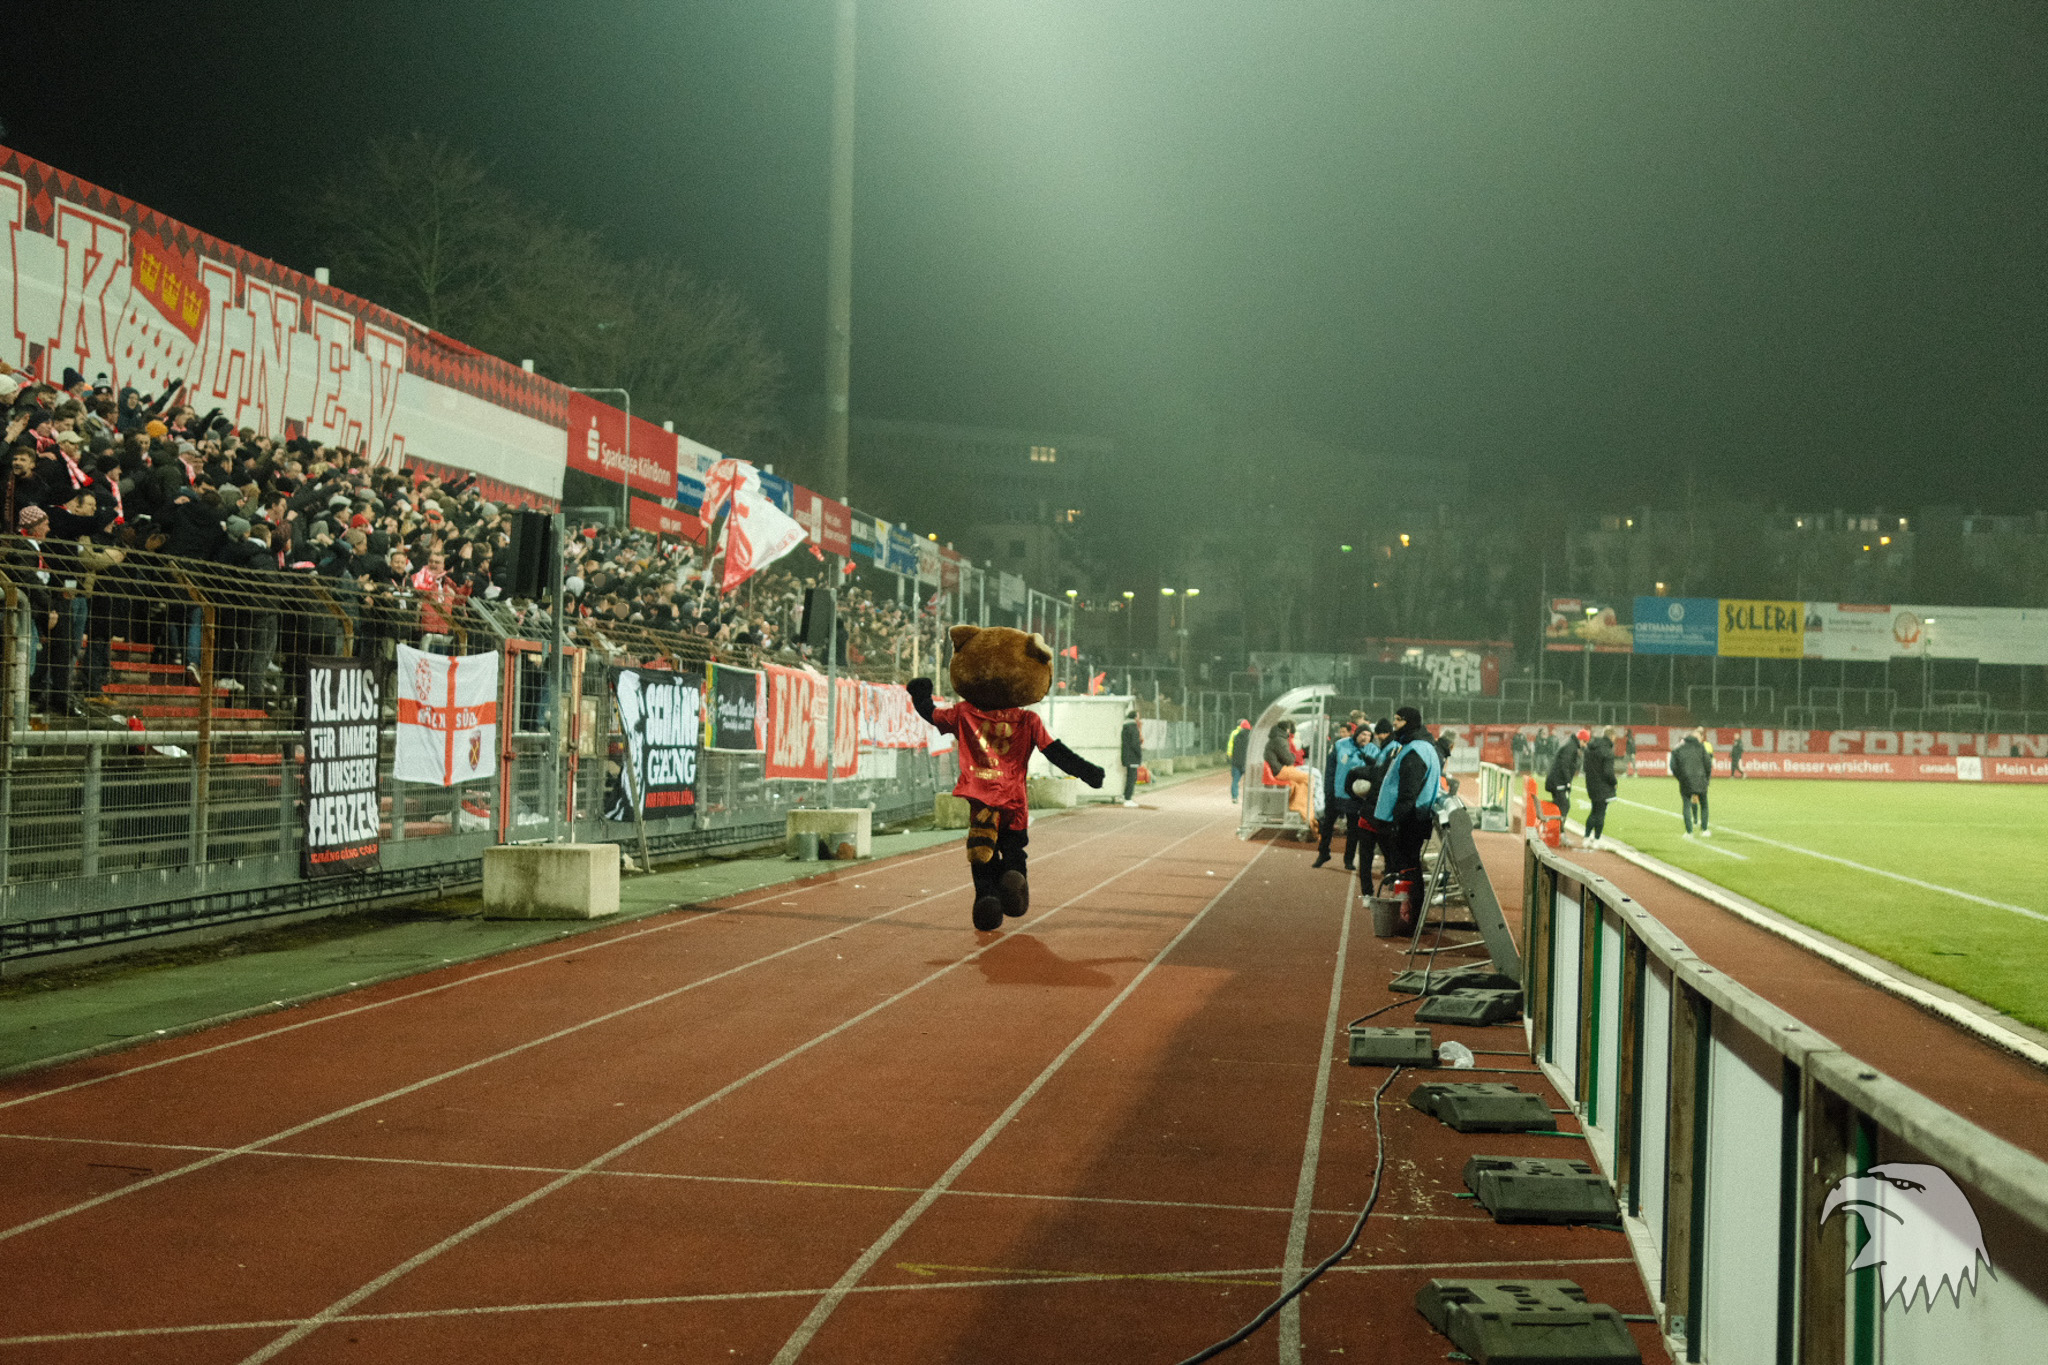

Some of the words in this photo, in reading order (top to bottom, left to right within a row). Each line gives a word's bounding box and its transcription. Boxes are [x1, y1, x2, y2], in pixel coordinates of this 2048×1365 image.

[601, 442, 638, 476] Sparkase
[1724, 602, 1798, 634] SOLERA
[309, 668, 379, 722] KLAUS:
[310, 726, 336, 759] FÜR
[339, 725, 378, 758] IMMER
[327, 758, 377, 792] UNSEREN
[647, 748, 697, 786] GÄNG
[1636, 758, 1666, 769] anada
[1783, 759, 1825, 772] Besser
[1827, 760, 1894, 774] versichert.
[1919, 762, 1956, 774] canada
[1996, 762, 2028, 776] Mein
[309, 792, 380, 847] HERZEN
